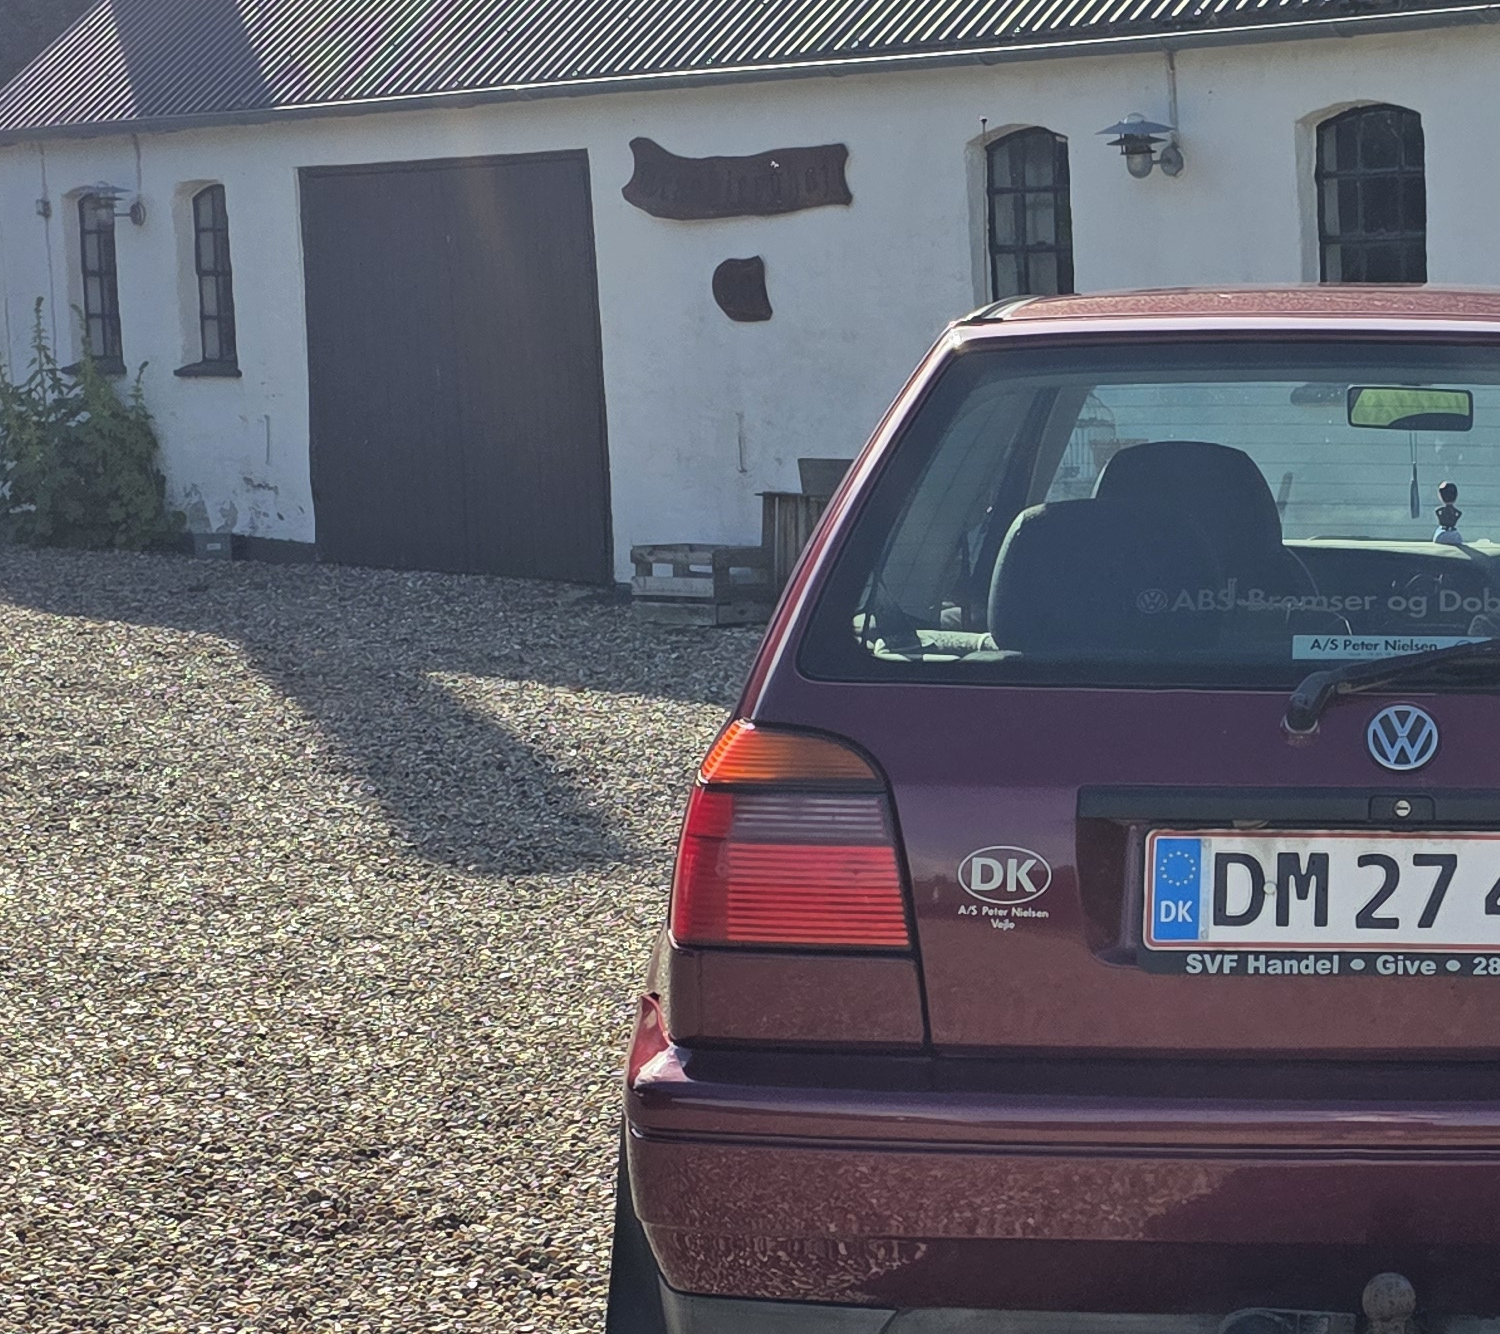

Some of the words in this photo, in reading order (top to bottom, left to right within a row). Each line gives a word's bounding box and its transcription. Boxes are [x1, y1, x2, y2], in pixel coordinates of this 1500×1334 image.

[1387, 594, 1428, 618] og
[1310, 637, 1339, 652] A/S
[1343, 638, 1379, 652] Peter
[1384, 638, 1438, 652] Nielsen
[970, 856, 1038, 893] DK
[1211, 851, 1330, 929] DM
[1354, 852, 1459, 931] 27
[957, 904, 978, 916] A/S
[981, 905, 1009, 917] Peter
[1011, 906, 1050, 919] Nielsen
[1158, 899, 1194, 925] DK
[1185, 953, 1239, 975] SVF
[1247, 954, 1340, 975] Handel
[1376, 954, 1437, 976] Give
